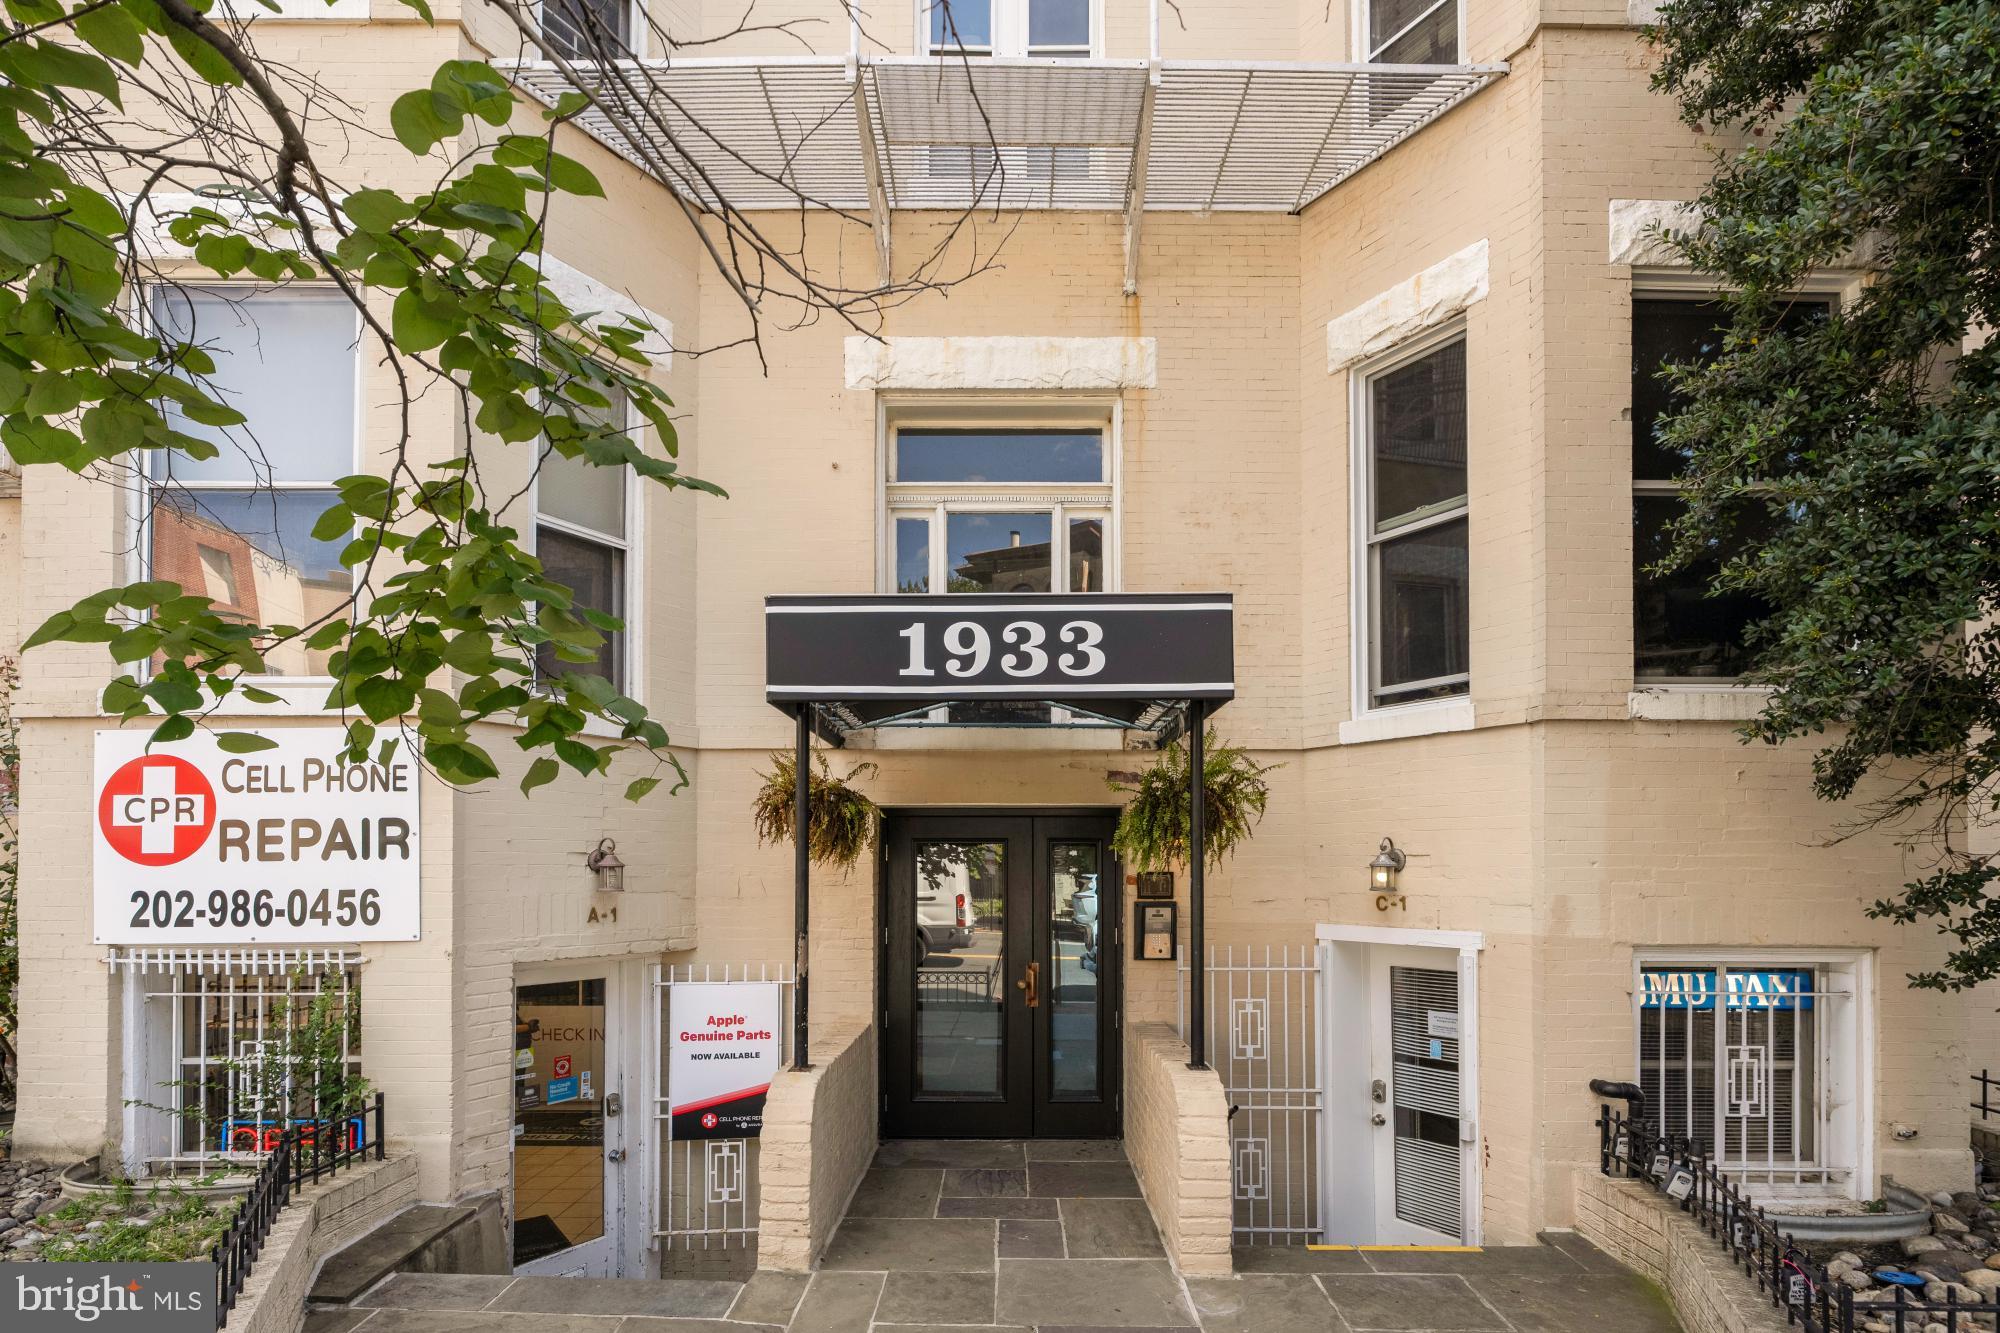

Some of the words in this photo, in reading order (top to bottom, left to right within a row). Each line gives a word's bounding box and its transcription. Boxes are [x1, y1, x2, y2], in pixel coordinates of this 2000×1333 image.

[899, 621, 1106, 678] 1933
[221, 758, 295, 793] CELL
[303, 758, 408, 793] PHONE
[124, 797, 195, 823] CPR
[218, 817, 410, 862] REPAIR
[130, 888, 381, 929] 202-986-0456
[587, 907, 617, 923] A-1
[1375, 895, 1407, 912] C-1
[1725, 974, 1796, 1006] TAX
[589, 1027, 604, 1041] IN
[706, 1014, 746, 1028] Apple
[680, 1031, 734, 1042] Genuine
[736, 1030, 772, 1041] Parts
[690, 1053, 712, 1061] NOW
[713, 1052, 761, 1060] AVAILABLE
[232, 1126, 356, 1152] OPE
